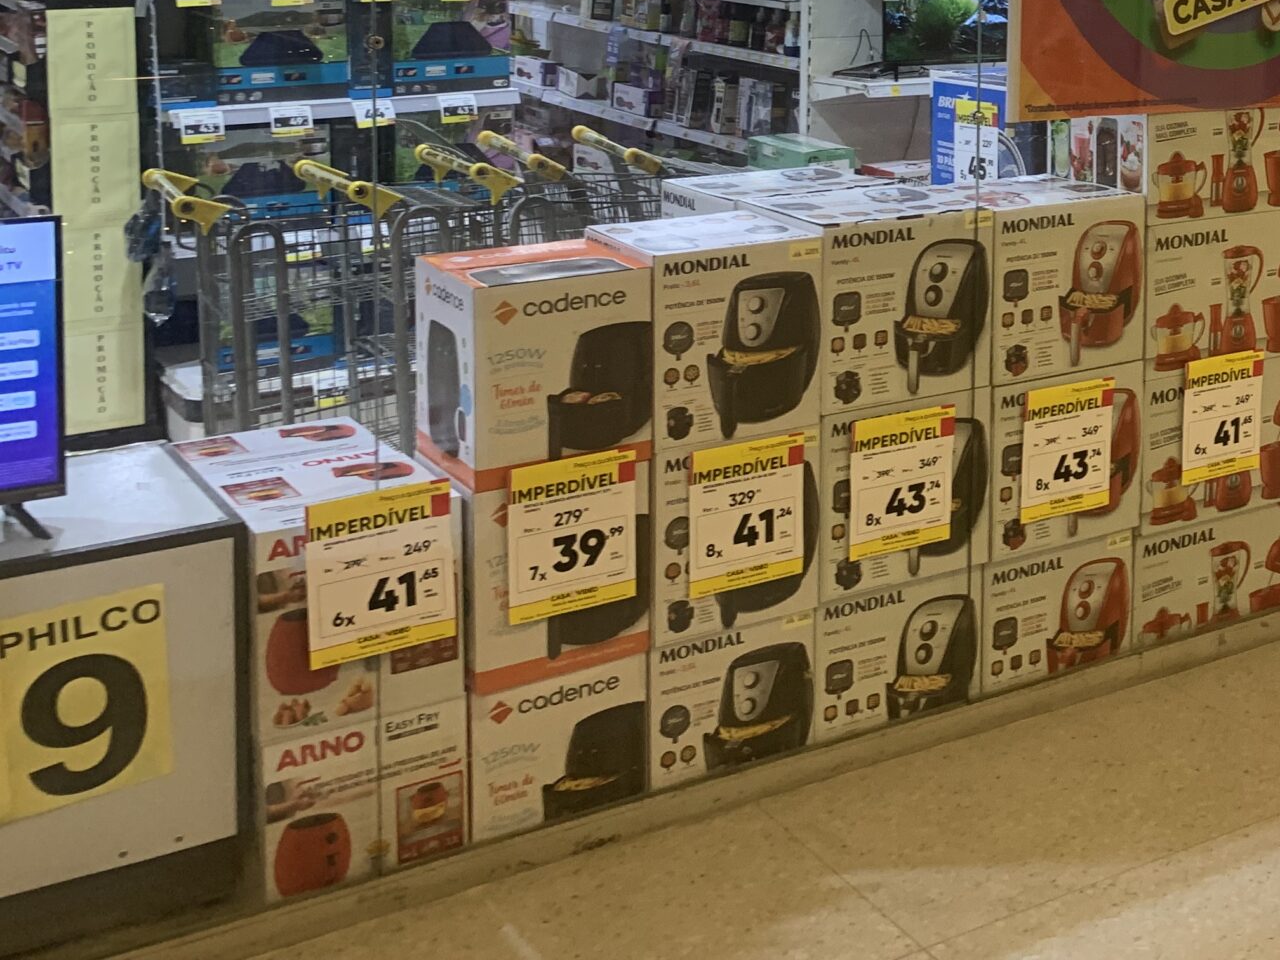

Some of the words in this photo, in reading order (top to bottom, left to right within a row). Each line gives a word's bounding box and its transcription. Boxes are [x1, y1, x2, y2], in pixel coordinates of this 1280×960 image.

[664, 190, 696, 211] MONDIAL
[1002, 213, 1075, 235] MONDIAL
[831, 227, 915, 250] MONDIAL
[1154, 229, 1228, 252] MONDIAL
[663, 253, 751, 277] MONDIAL
[433, 283, 464, 312] cadence
[523, 290, 626, 317] cadence
[1188, 368, 1252, 389] IMPERDÍVEL
[1028, 397, 1101, 421] IMPERDÍVEL
[855, 427, 940, 453] IMPERDÍVEL
[1194, 443, 1207, 455] 6x
[693, 455, 787, 485] IMPERDÍVEL
[512, 472, 617, 505] IMPERDÍVEL
[1035, 478, 1050, 491] 8x
[310, 505, 431, 542] IMPERDÍVEL
[866, 513, 882, 526] 8x
[706, 544, 723, 558] 8x
[1142, 527, 1216, 558] MONDIAL
[529, 566, 547, 581] 7x
[991, 557, 1064, 586] MONDIAL
[824, 590, 905, 622] MONDIAL
[0, 598, 161, 660] PHILCO
[333, 612, 356, 627] 6x
[659, 631, 745, 665] MONDIAL
[518, 675, 620, 715] cadence
[20, 653, 149, 796] 9
[276, 731, 365, 772] ARNO
